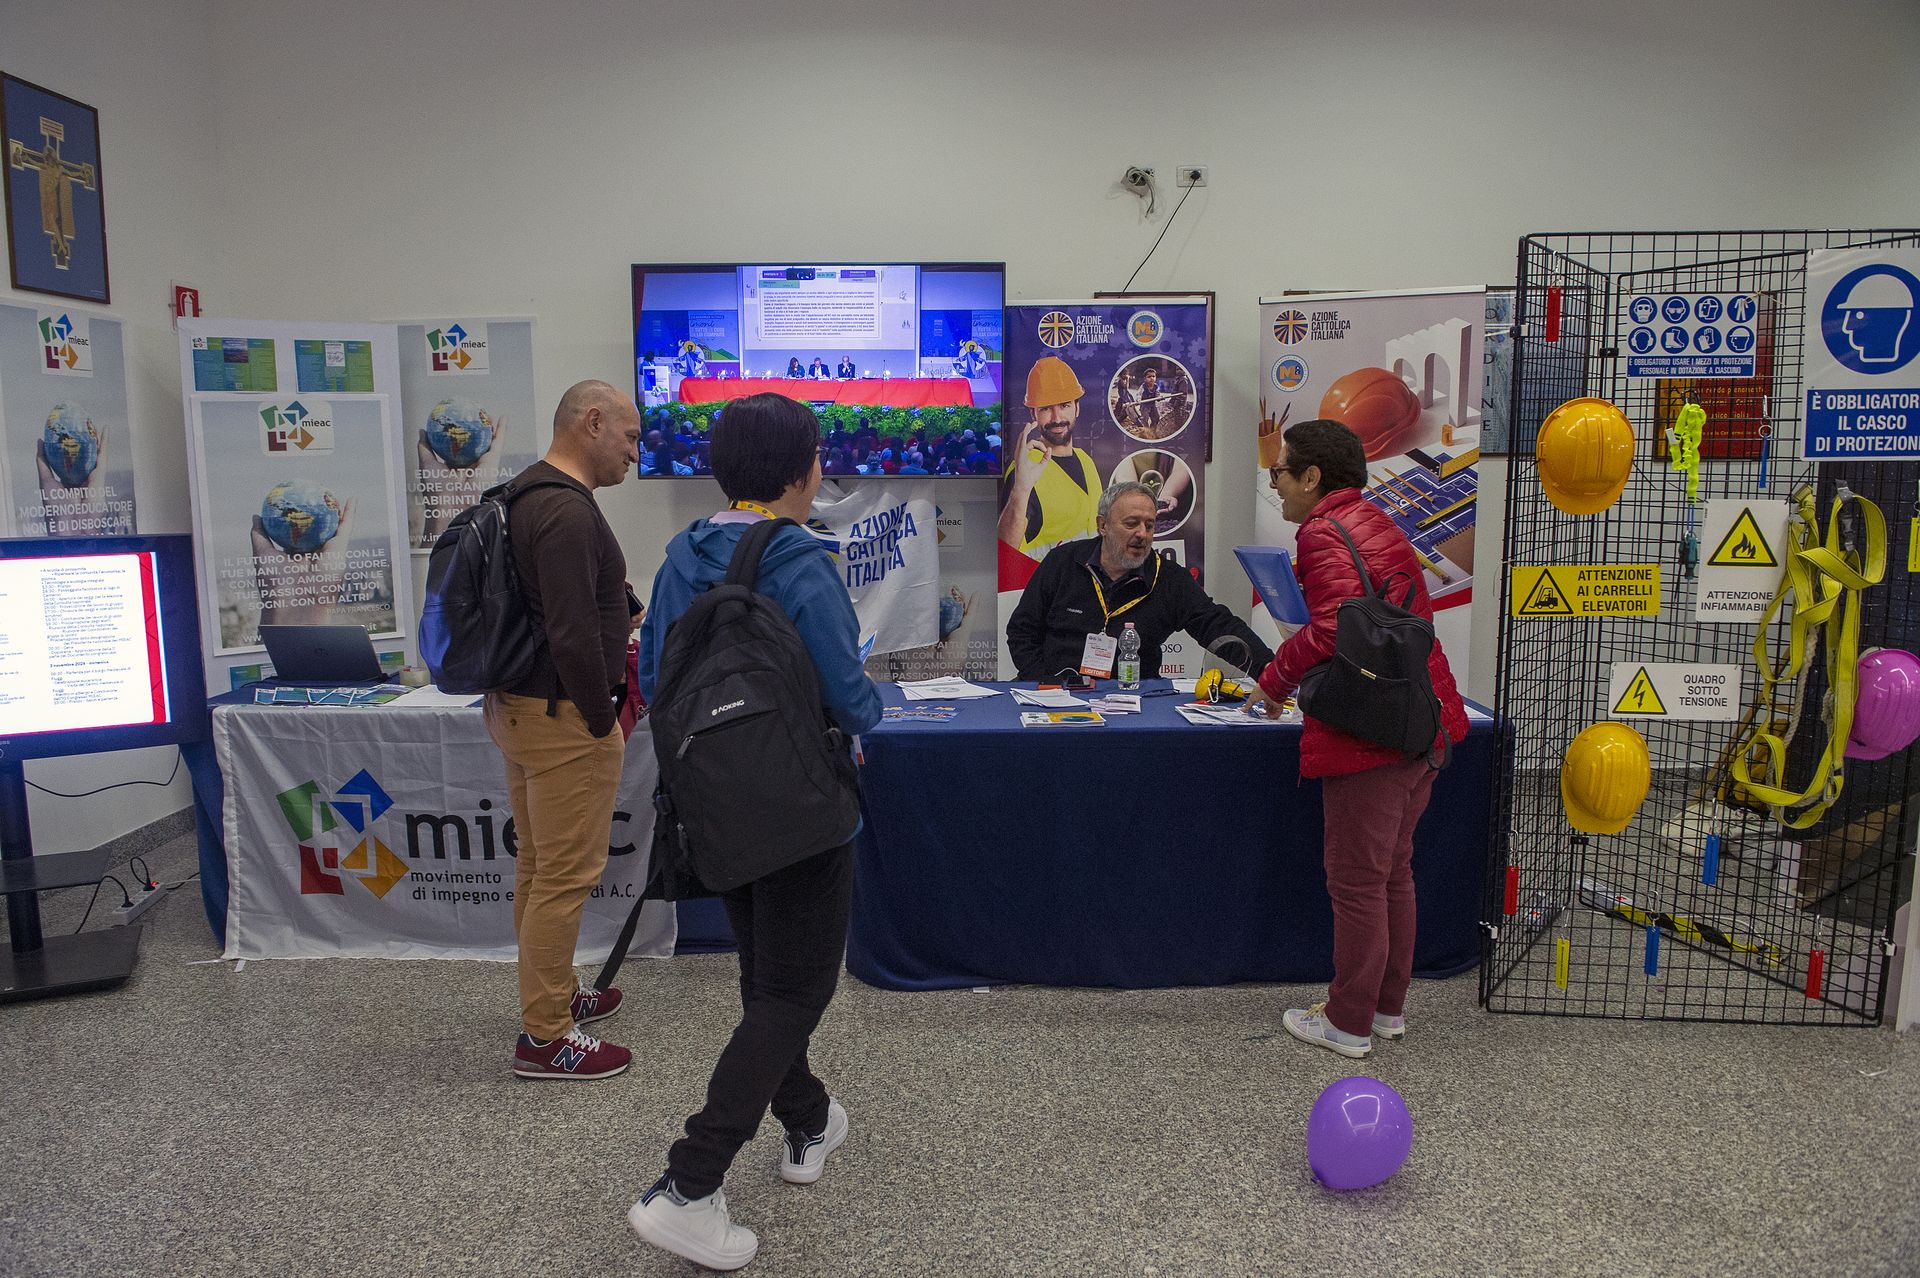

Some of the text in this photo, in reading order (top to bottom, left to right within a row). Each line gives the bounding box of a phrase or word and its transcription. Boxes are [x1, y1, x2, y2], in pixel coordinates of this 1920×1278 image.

[1076, 315, 1102, 325] AZIONE
[1311, 310, 1339, 322] AZIONE
[1076, 324, 1115, 335] CATTOLICA
[1311, 320, 1351, 331] CATTOLICA
[68, 336, 89, 346] mieac
[1075, 334, 1109, 344] ITALIANA
[1311, 330, 1345, 341] ITALIANA
[461, 339, 487, 349] mieac
[1634, 358, 1671, 366] OBBLIGATORIO
[1673, 358, 1690, 366] USARE
[1695, 358, 1712, 366] MEZZI
[1714, 358, 1719, 366] DI
[1721, 357, 1752, 366] PROTEZIONE
[1639, 367, 1669, 375] PERSONALE
[1671, 367, 1677, 375] IN
[1679, 367, 1707, 375] DOTAZIONE
[1715, 366, 1741, 374] CIASCUNO
[1812, 392, 1920, 410] È OBBLIGATOR
[302, 418, 331, 428] mieac
[1838, 414, 1907, 431] IL CASCO
[1815, 435, 1920, 452] DI PROTEZION
[415, 467, 488, 479] EDUCATORI
[50, 487, 96, 500] COMPITO
[23, 522, 47, 535] NON
[58, 521, 69, 532] DI
[71, 516, 132, 531] DISBOSCARE
[936, 518, 962, 526] mieac
[224, 558, 234, 567] IL
[237, 554, 285, 566] FUTURO
[287, 553, 301, 564] LO
[305, 552, 324, 562] FAI
[345, 549, 370, 559] CON
[372, 548, 385, 557] LE
[220, 568, 245, 578] TUE
[283, 563, 309, 574] CON
[311, 563, 322, 572] IL
[323, 561, 347, 571] TUO
[1577, 568, 1653, 582] ATTENZIONE
[229, 580, 255, 590] CON
[258, 579, 268, 588] IL
[270, 576, 294, 587] TUO
[343, 571, 368, 581] CON
[371, 570, 384, 579] LE
[235, 590, 259, 600] TUE
[320, 583, 346, 594] CON
[353, 581, 380, 591] TUOI
[1577, 584, 1653, 598] AI CARRELLI
[1706, 591, 1774, 601] ATTENZIONE
[290, 597, 316, 607] CON
[318, 595, 336, 605] GLI
[338, 593, 370, 603] ALTRI
[347, 603, 391, 614] FRANCESCO
[1581, 600, 1648, 613] ELEVATORI
[1700, 601, 1770, 613] INFIAMMABIL
[968, 640, 989, 649] CON
[912, 651, 934, 660] CON
[936, 651, 945, 660] IL
[969, 651, 998, 660] CUOR
[890, 662, 899, 670] IL
[900, 661, 921, 670] TUO
[965, 661, 987, 669] CON
[1683, 674, 1726, 686] QUADRO
[1687, 685, 1721, 696] SOTTO
[1679, 696, 1728, 708] TENSIONE
[410, 870, 502, 885] movimento
[412, 886, 428, 902] di
[431, 887, 501, 905] impegno
[590, 883, 636, 899] di A.C.
